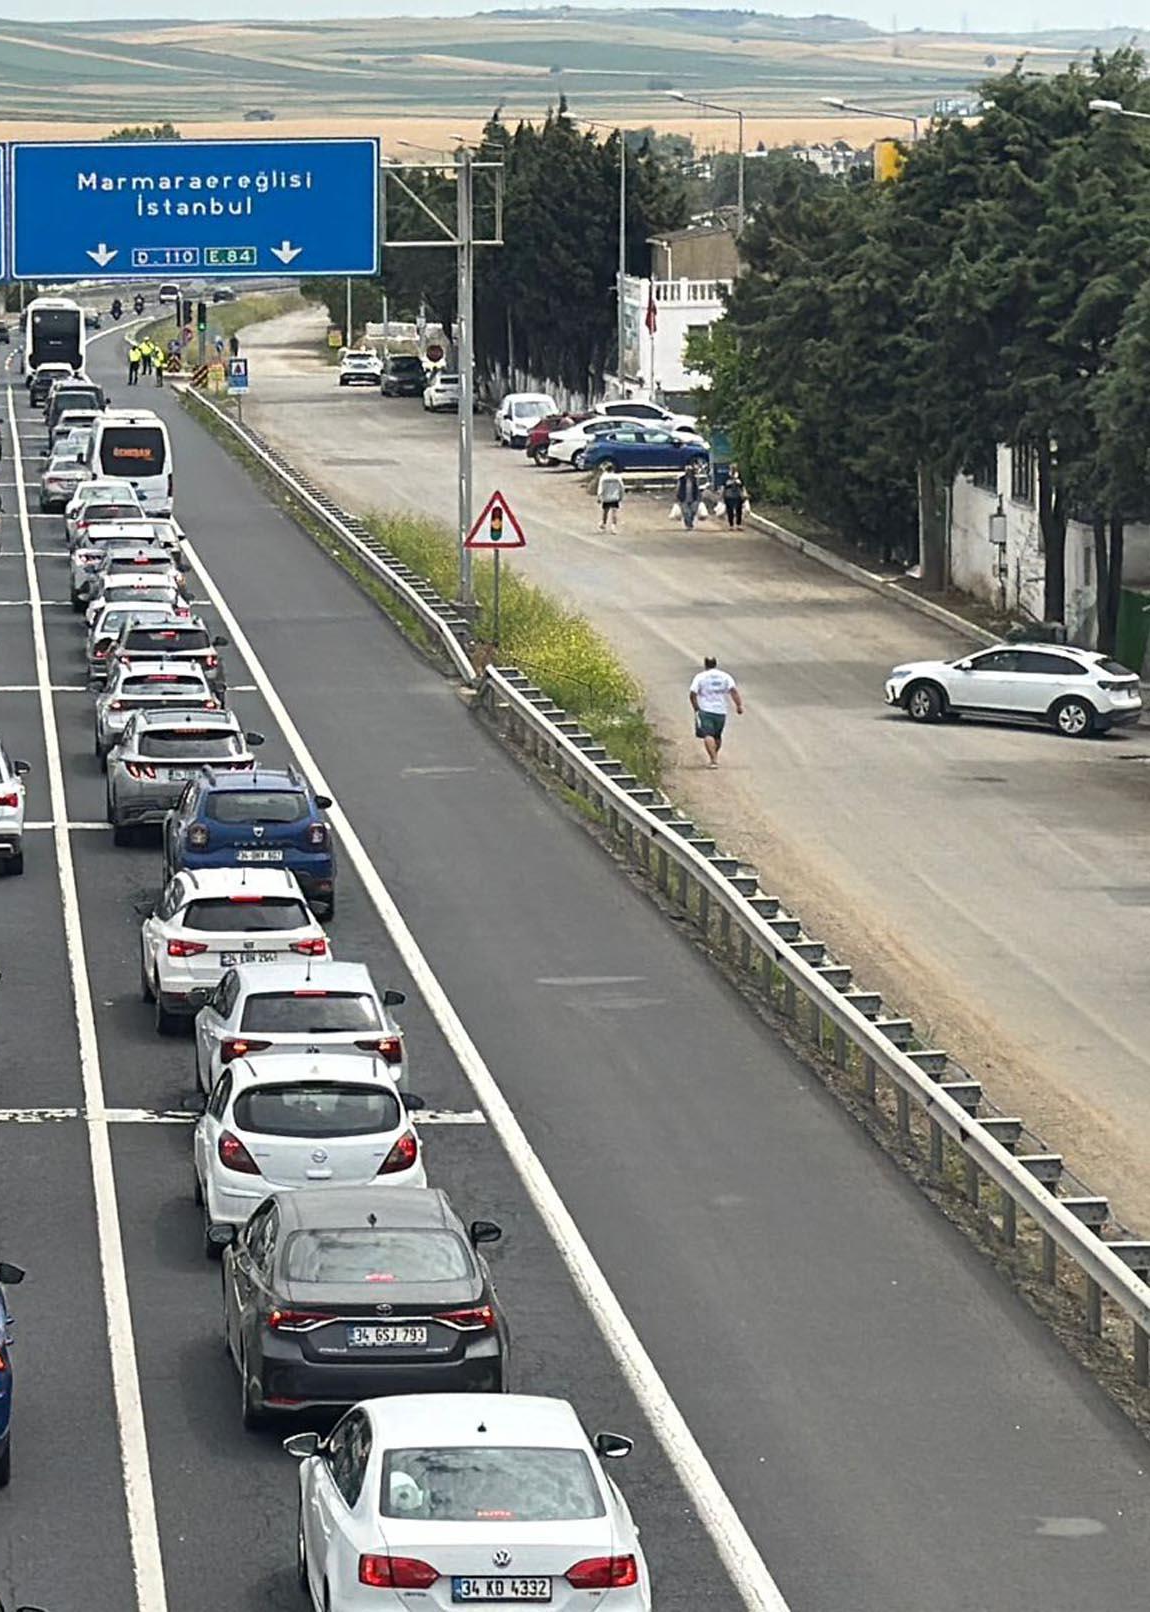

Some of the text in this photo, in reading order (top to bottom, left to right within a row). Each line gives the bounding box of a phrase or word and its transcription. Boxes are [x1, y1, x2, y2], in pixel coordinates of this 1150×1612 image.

[78, 171, 312, 193] Marmaraereğlisi
[137, 194, 252, 216] İstanbul
[356, 1328, 424, 1341] 34 GSJ 793
[462, 1580, 547, 1597] 34 KD 4332
